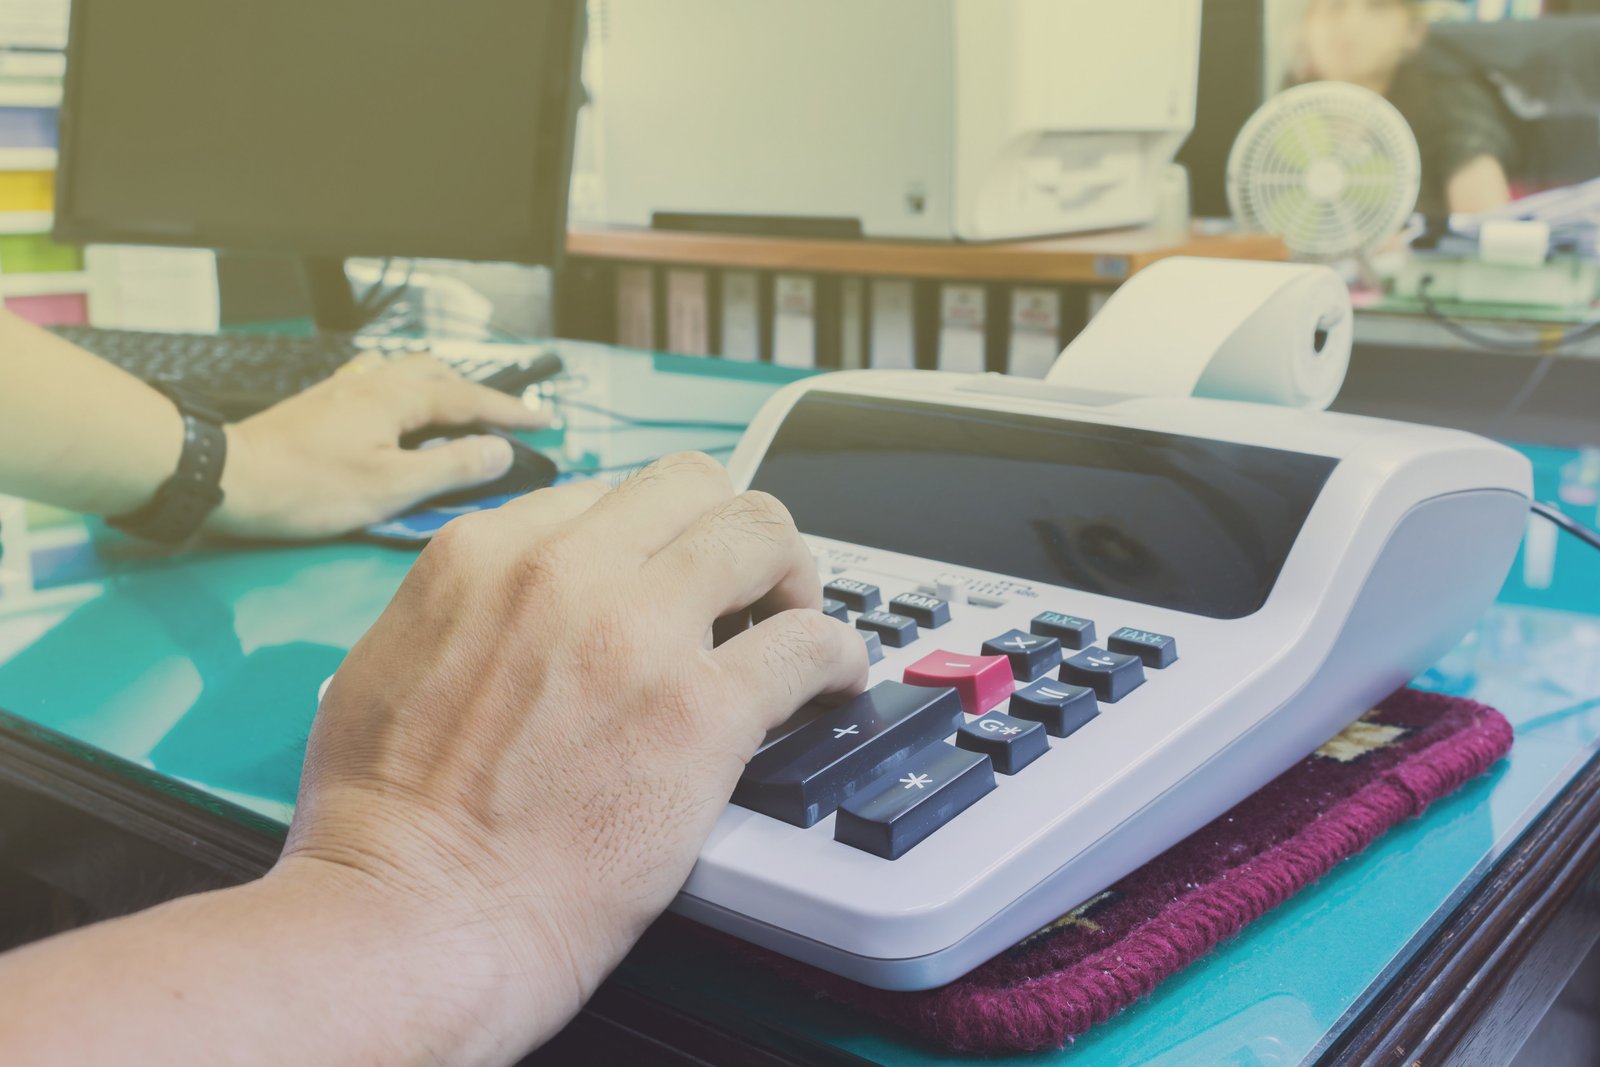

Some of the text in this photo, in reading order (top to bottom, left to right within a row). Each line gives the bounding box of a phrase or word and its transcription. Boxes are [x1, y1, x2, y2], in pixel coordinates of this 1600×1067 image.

[831, 579, 868, 593] SELL
[896, 593, 940, 609] MAR
[1119, 629, 1163, 643] TAX+
